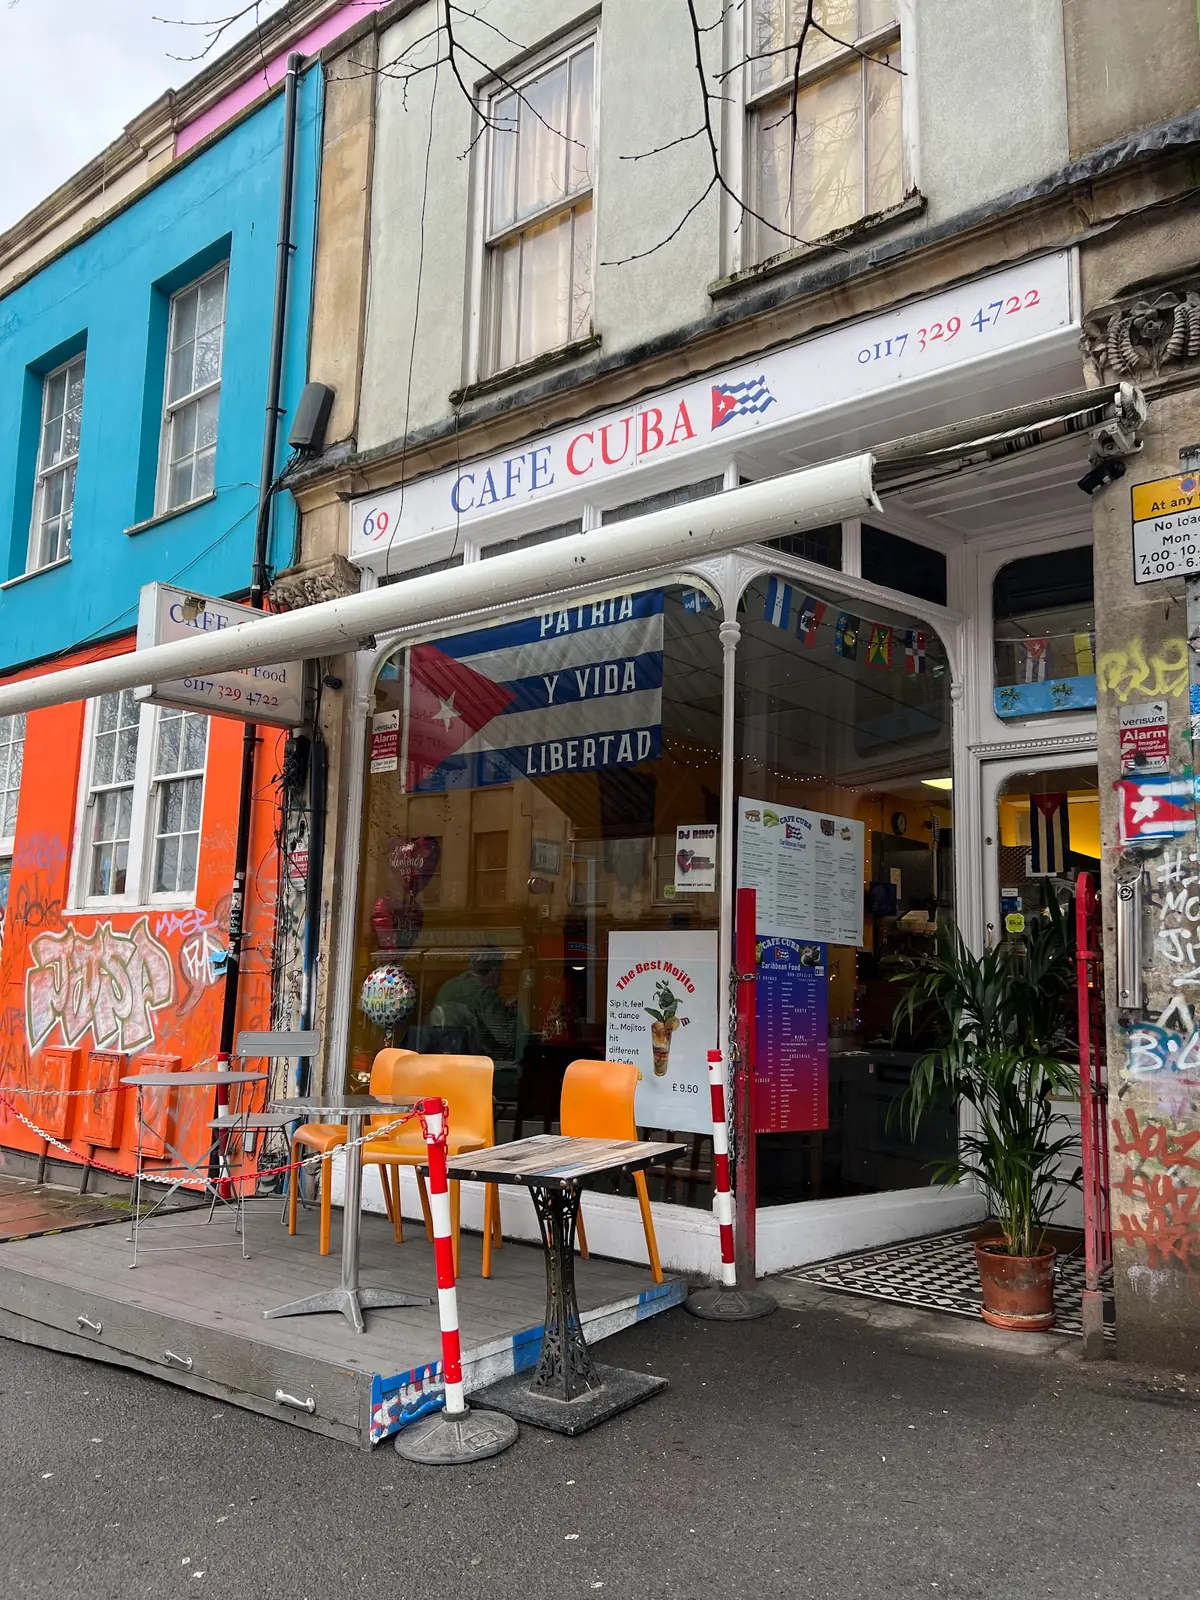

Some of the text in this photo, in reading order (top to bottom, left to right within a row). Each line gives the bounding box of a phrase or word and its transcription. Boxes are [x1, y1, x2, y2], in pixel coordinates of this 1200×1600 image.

[857, 289, 1041, 364] 0117 329 4722
[451, 399, 697, 513] CAFE CUBA
[1151, 496, 1193, 512] At any
[363, 508, 389, 540] 69
[1155, 521, 1172, 532] No
[1163, 534, 1190, 546] Mon
[1139, 550, 1170, 564] 7.00
[1142, 561, 1174, 575] 4.00
[254, 665, 286, 683] Food
[543, 661, 636, 704] Y VIDA
[183, 678, 279, 706] 0117 329 4722
[1122, 715, 1165, 726] verisure
[374, 723, 398, 731] verisure
[374, 734, 397, 744] Alarm
[1123, 730, 1166, 741] Alarm
[526, 730, 651, 774] LIBERTAD
[1138, 743, 1166, 751] recorded
[780, 815, 812, 831] CAFE CUBA
[762, 938, 800, 952] CAFE CUBA
[761, 962, 800, 971] Caribbean Food
[615, 960, 695, 993] The Best Mojito
[609, 1000, 621, 1008] Sip
[631, 1000, 644, 1008] feel
[618, 1011, 639, 1019] dance
[620, 1023, 646, 1032] Mojitos
[609, 1034, 619, 1042] hit
[609, 1046, 639, 1055] different
[680, 1083, 699, 1094] 9.50
